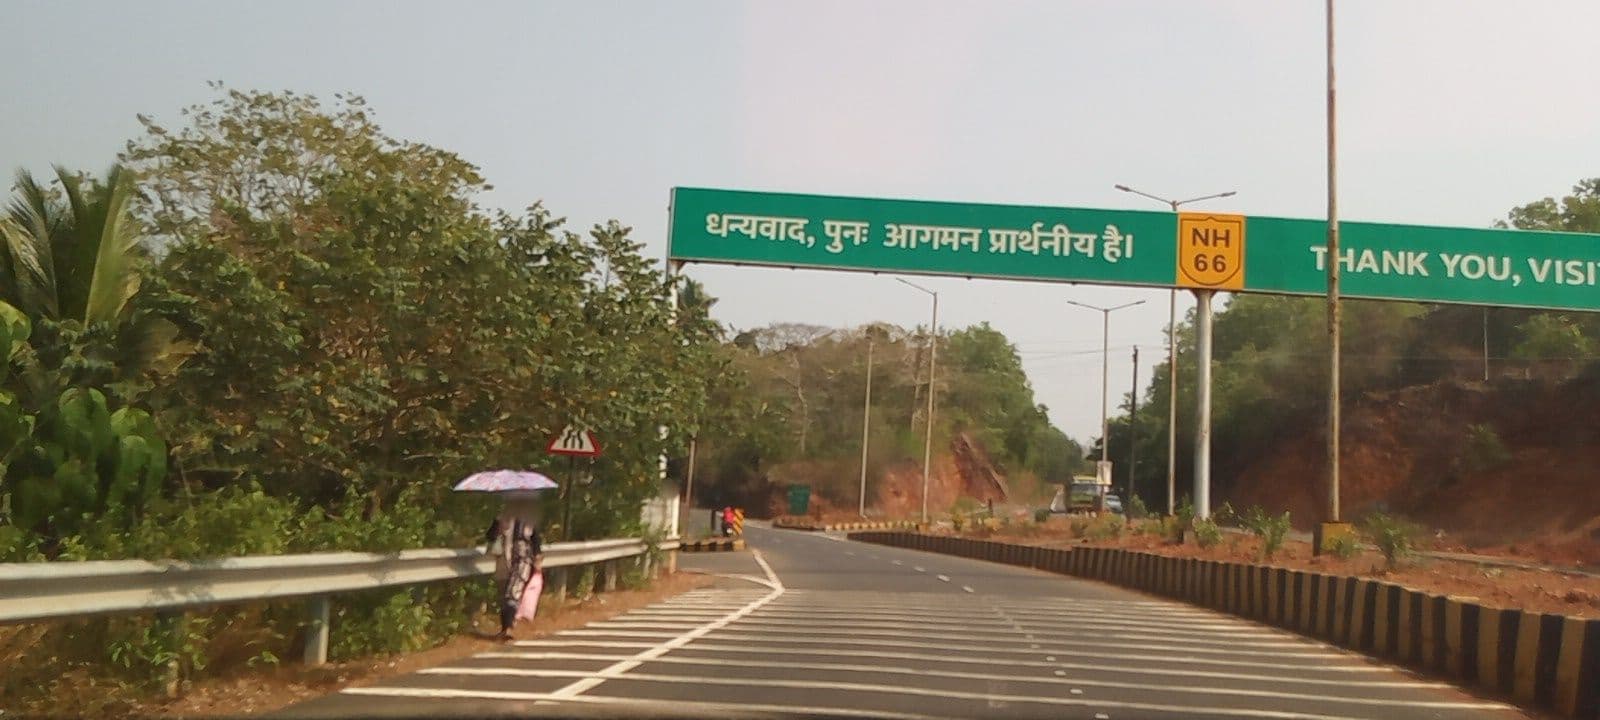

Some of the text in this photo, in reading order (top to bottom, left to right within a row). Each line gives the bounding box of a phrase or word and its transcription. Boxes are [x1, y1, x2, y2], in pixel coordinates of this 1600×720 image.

[706, 213, 1133, 263] धन्यवाद, पुनः आगमन प्रार्थनीय है।
[1192, 228, 1230, 248] NH
[1194, 253, 1226, 273] 66
[1310, 246, 1600, 287] THANK YOU, VISI
